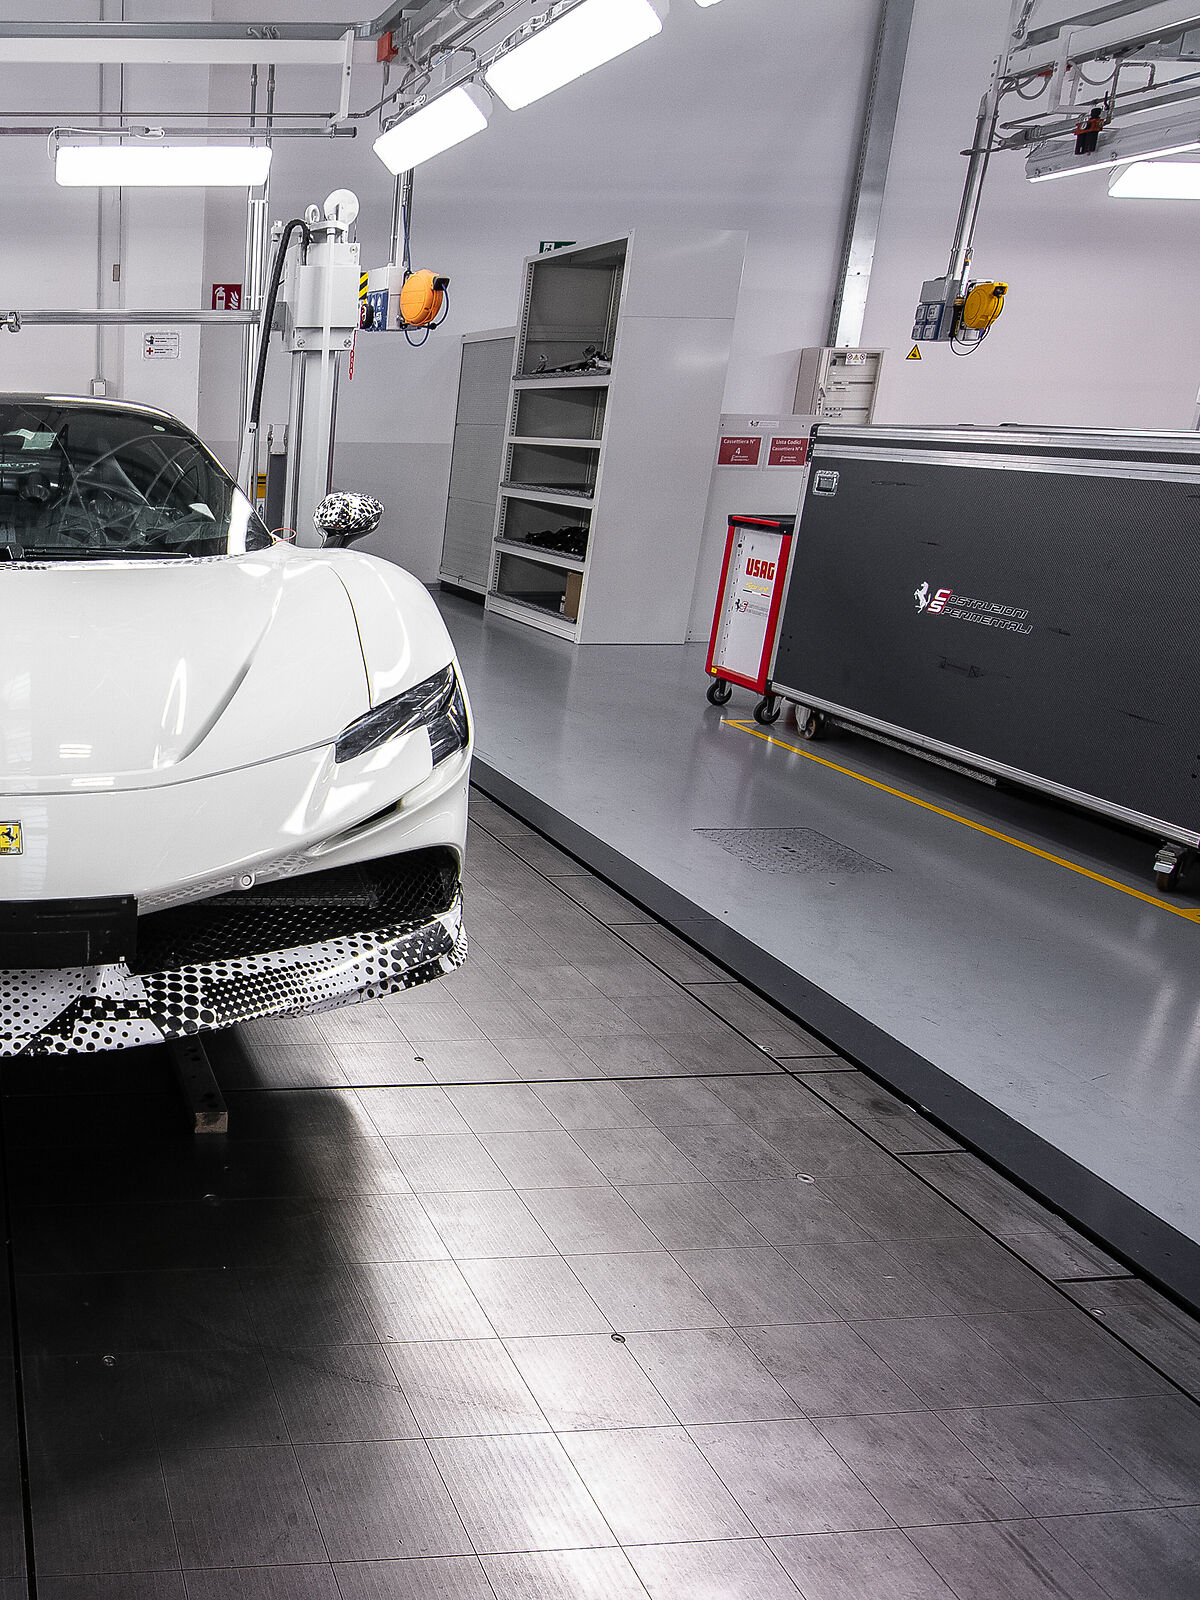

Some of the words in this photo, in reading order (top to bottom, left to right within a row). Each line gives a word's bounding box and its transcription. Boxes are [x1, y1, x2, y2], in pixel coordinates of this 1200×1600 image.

[735, 447, 741, 455] 4
[746, 557, 776, 580] USAG
[934, 589, 1029, 619] COSTRUZIONI
[927, 601, 1033, 635] SPERIMENTALI
